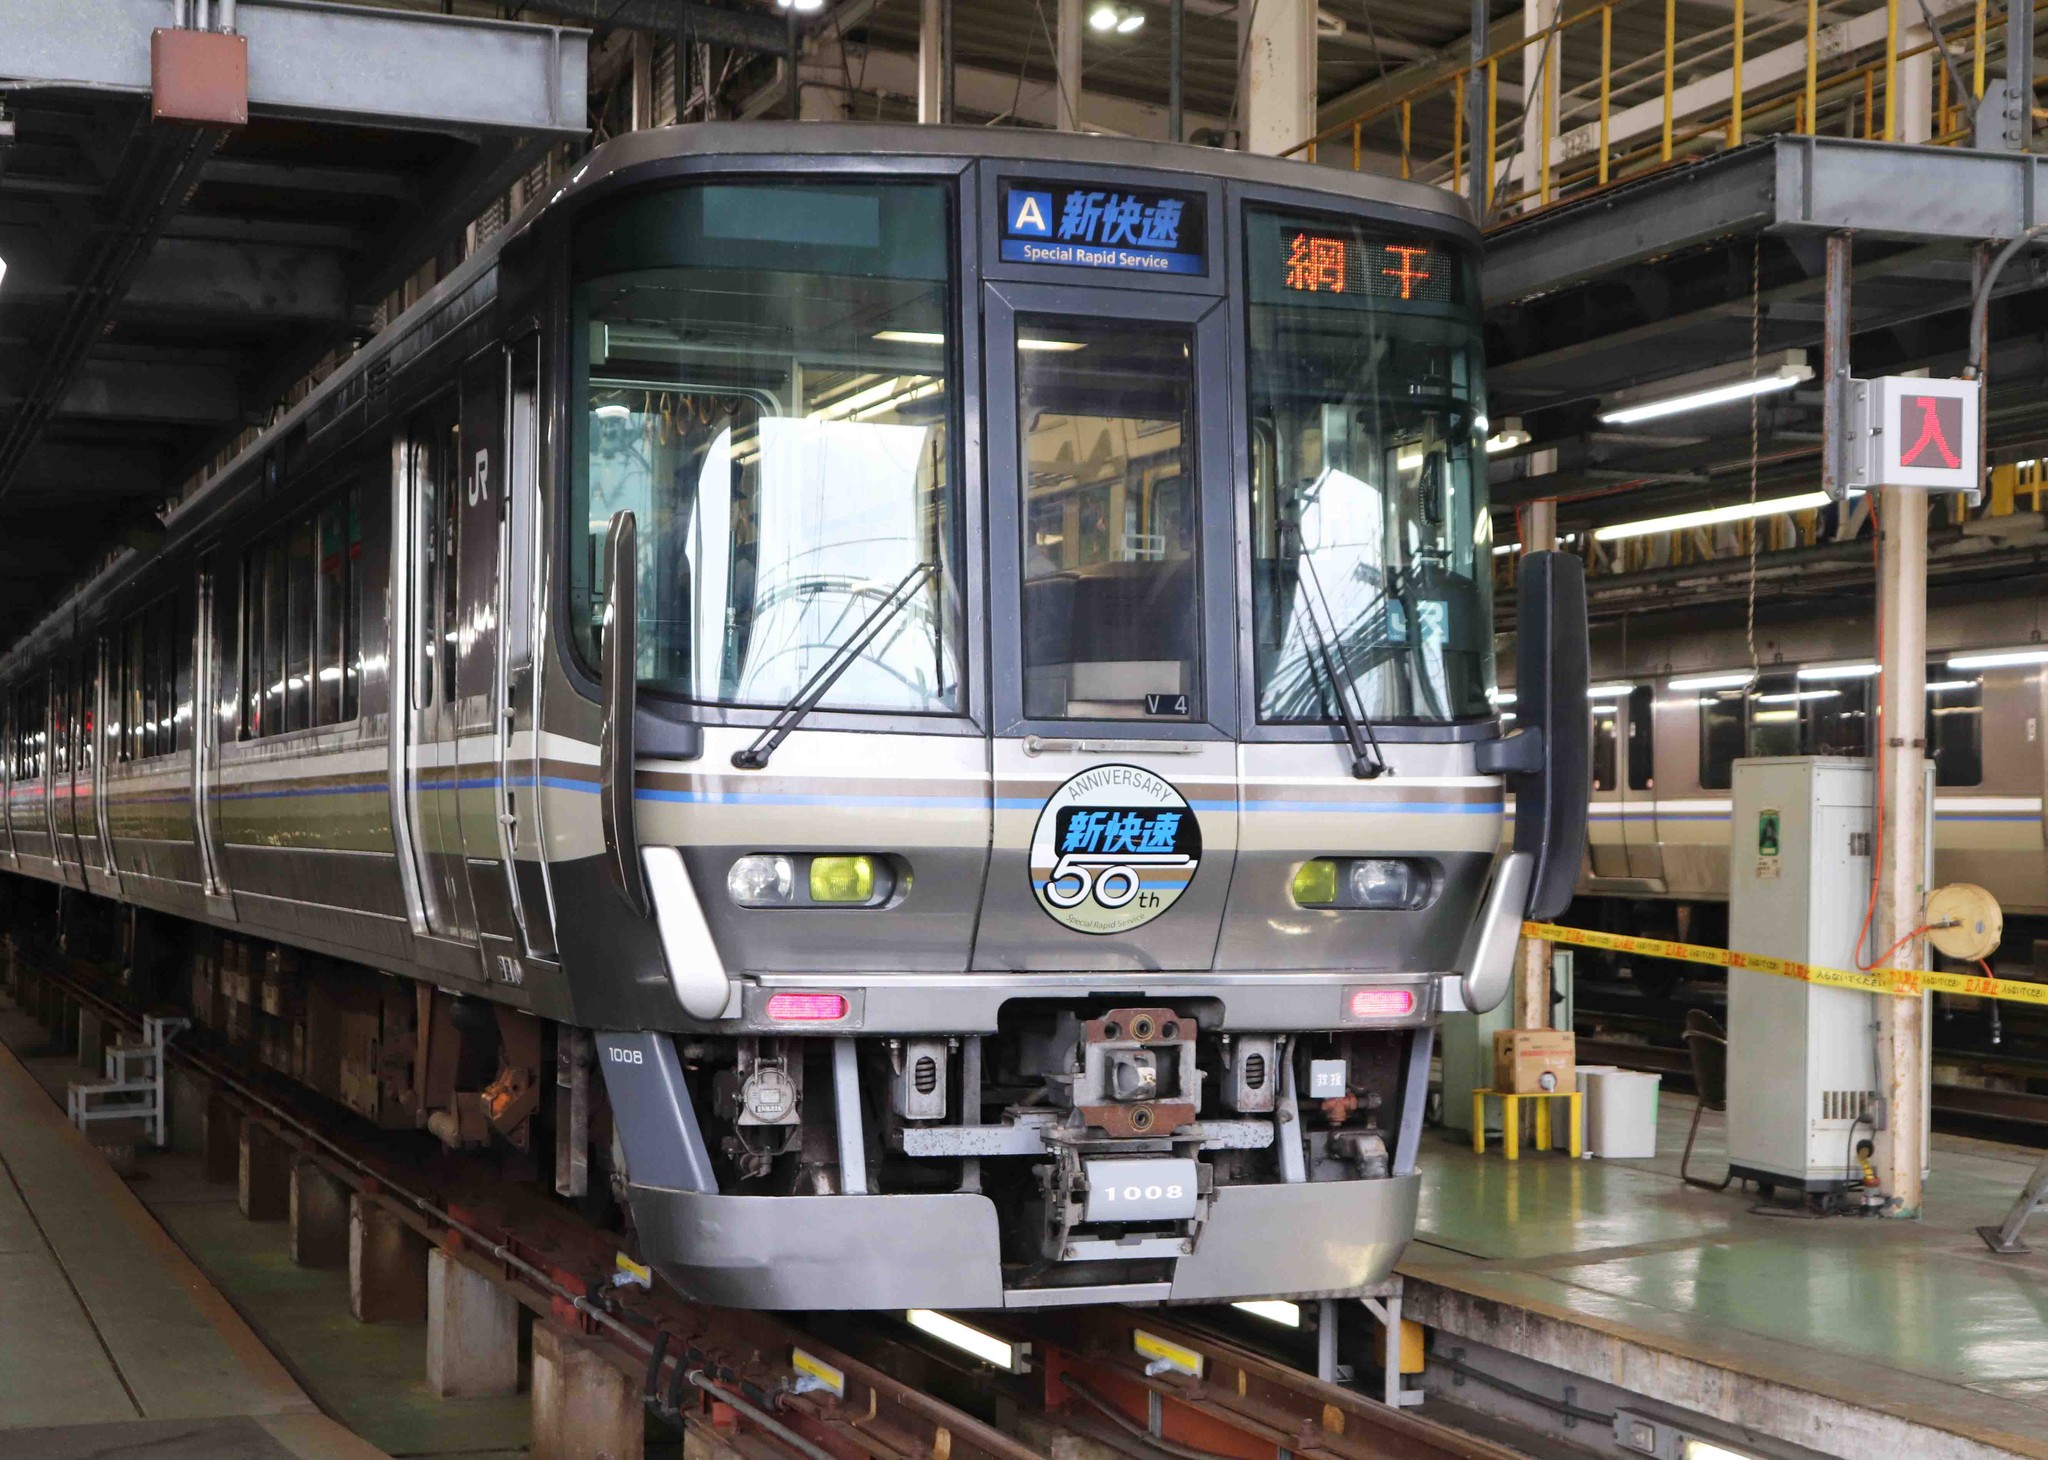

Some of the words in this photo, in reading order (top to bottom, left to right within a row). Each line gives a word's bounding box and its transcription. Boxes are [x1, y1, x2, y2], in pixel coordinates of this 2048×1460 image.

[1015, 196, 1046, 231] A
[1058, 191, 1184, 248] 新快速
[1023, 244, 1073, 261] Special
[1076, 249, 1116, 267] Rapid
[1119, 253, 1169, 269] Service
[1286, 233, 1430, 299] 網干
[1900, 397, 1961, 469] 入
[468, 447, 488, 507] JR
[1147, 695, 1160, 714] V
[1174, 695, 1188, 714] 4
[1067, 769, 1172, 802] ANNIVERSARY
[1061, 811, 1182, 853] 新快速
[1065, 913, 1093, 929] Special
[1093, 920, 1116, 931] Rapid
[1117, 913, 1146, 927] Service
[1816, 970, 1886, 988] 入らないでください
[1963, 977, 1999, 997] 立入禁止
[608, 1047, 643, 1065] 1008
[1105, 1185, 1183, 1201] 1008
